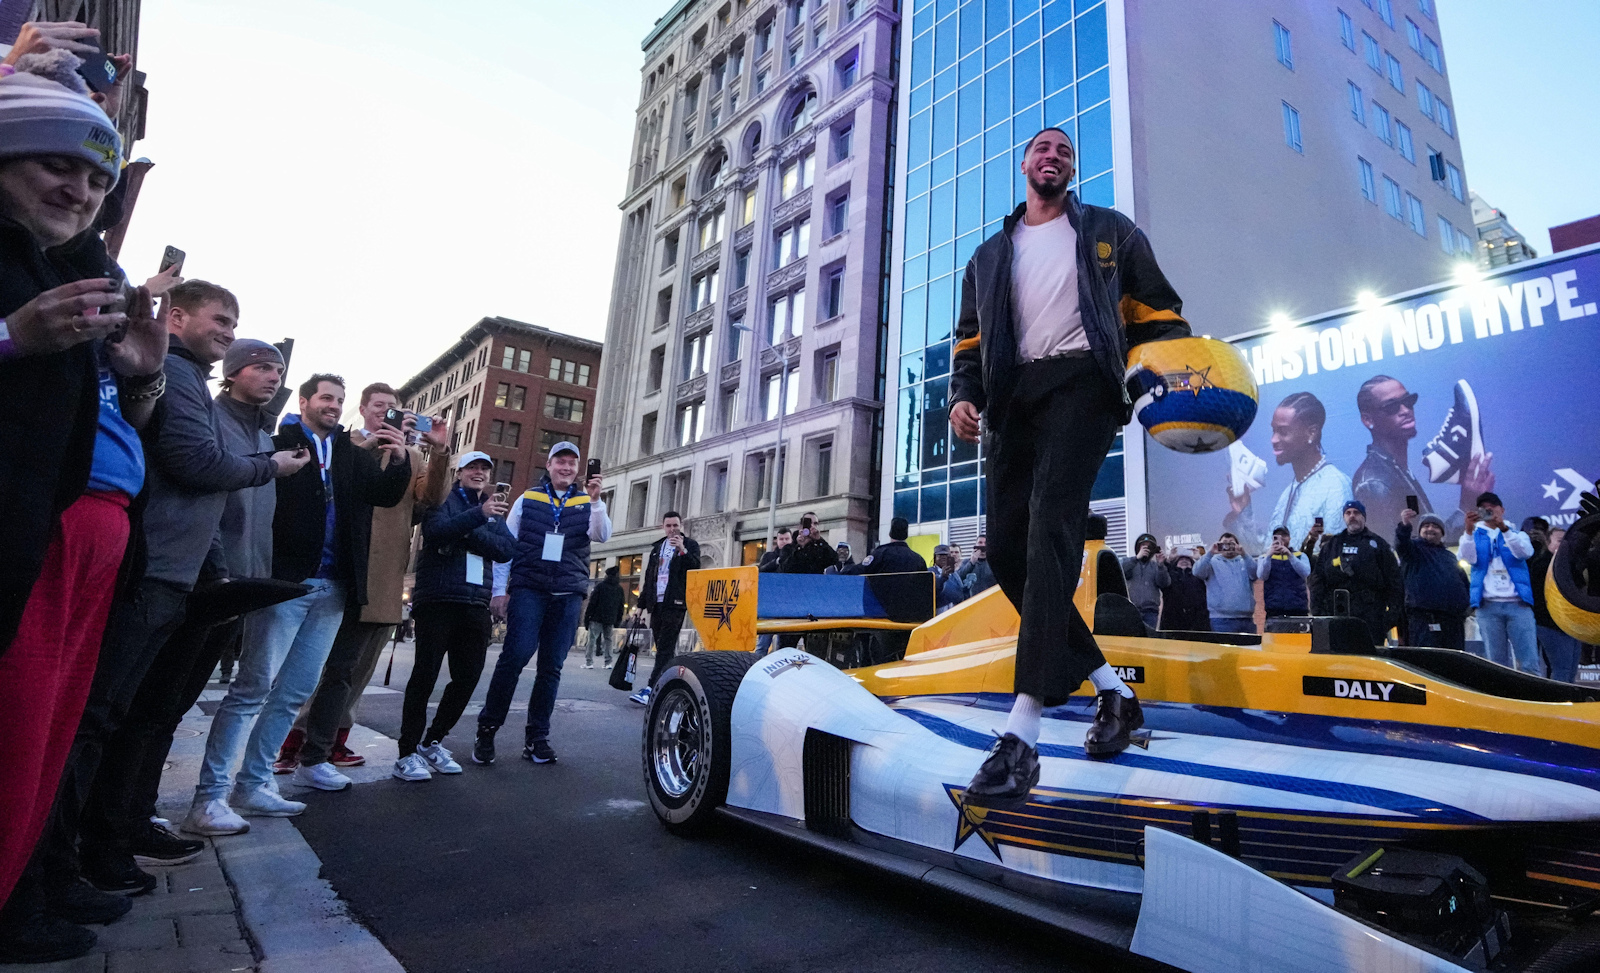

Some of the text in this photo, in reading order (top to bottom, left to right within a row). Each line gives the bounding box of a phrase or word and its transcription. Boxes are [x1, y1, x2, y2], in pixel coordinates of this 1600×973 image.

[1252, 269, 1598, 386] HISTORY NOT HYPE.
[706, 579, 740, 602] INDY 24
[763, 658, 790, 675] INDY
[1334, 679, 1395, 701] DALY
